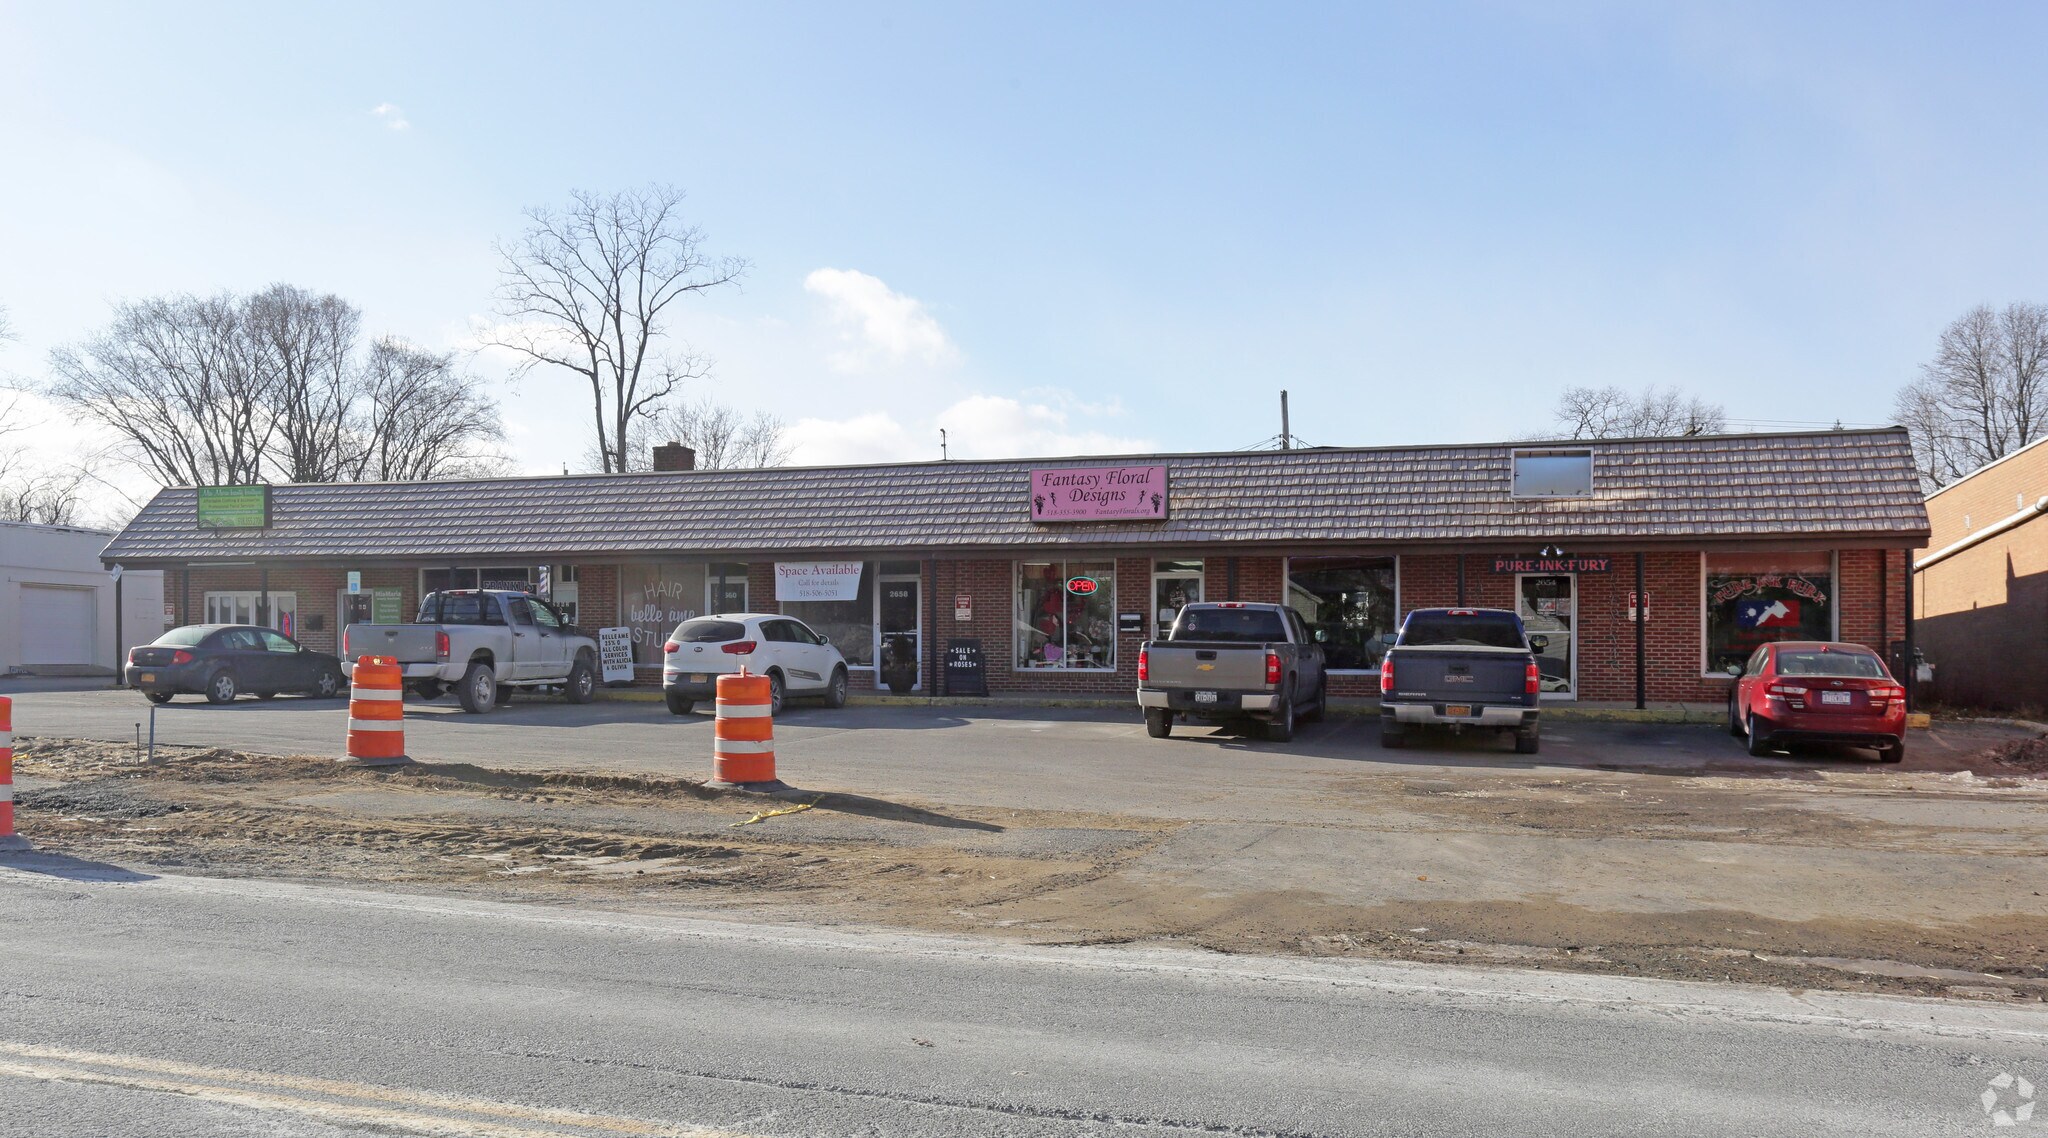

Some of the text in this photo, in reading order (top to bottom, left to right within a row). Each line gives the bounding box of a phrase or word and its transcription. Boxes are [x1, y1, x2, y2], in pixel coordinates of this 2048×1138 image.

[1041, 468, 1154, 490] Fantasy Floral
[1069, 486, 1126, 506] Designs
[779, 563, 860, 578] Space Available
[798, 578, 840, 587] Call for details
[1068, 581, 1096, 591] OPEN
[644, 581, 683, 600] HAIR
[630, 604, 664, 623] belle
[604, 651, 628, 659] SERVICES
[1444, 675, 1474, 683] GMC
